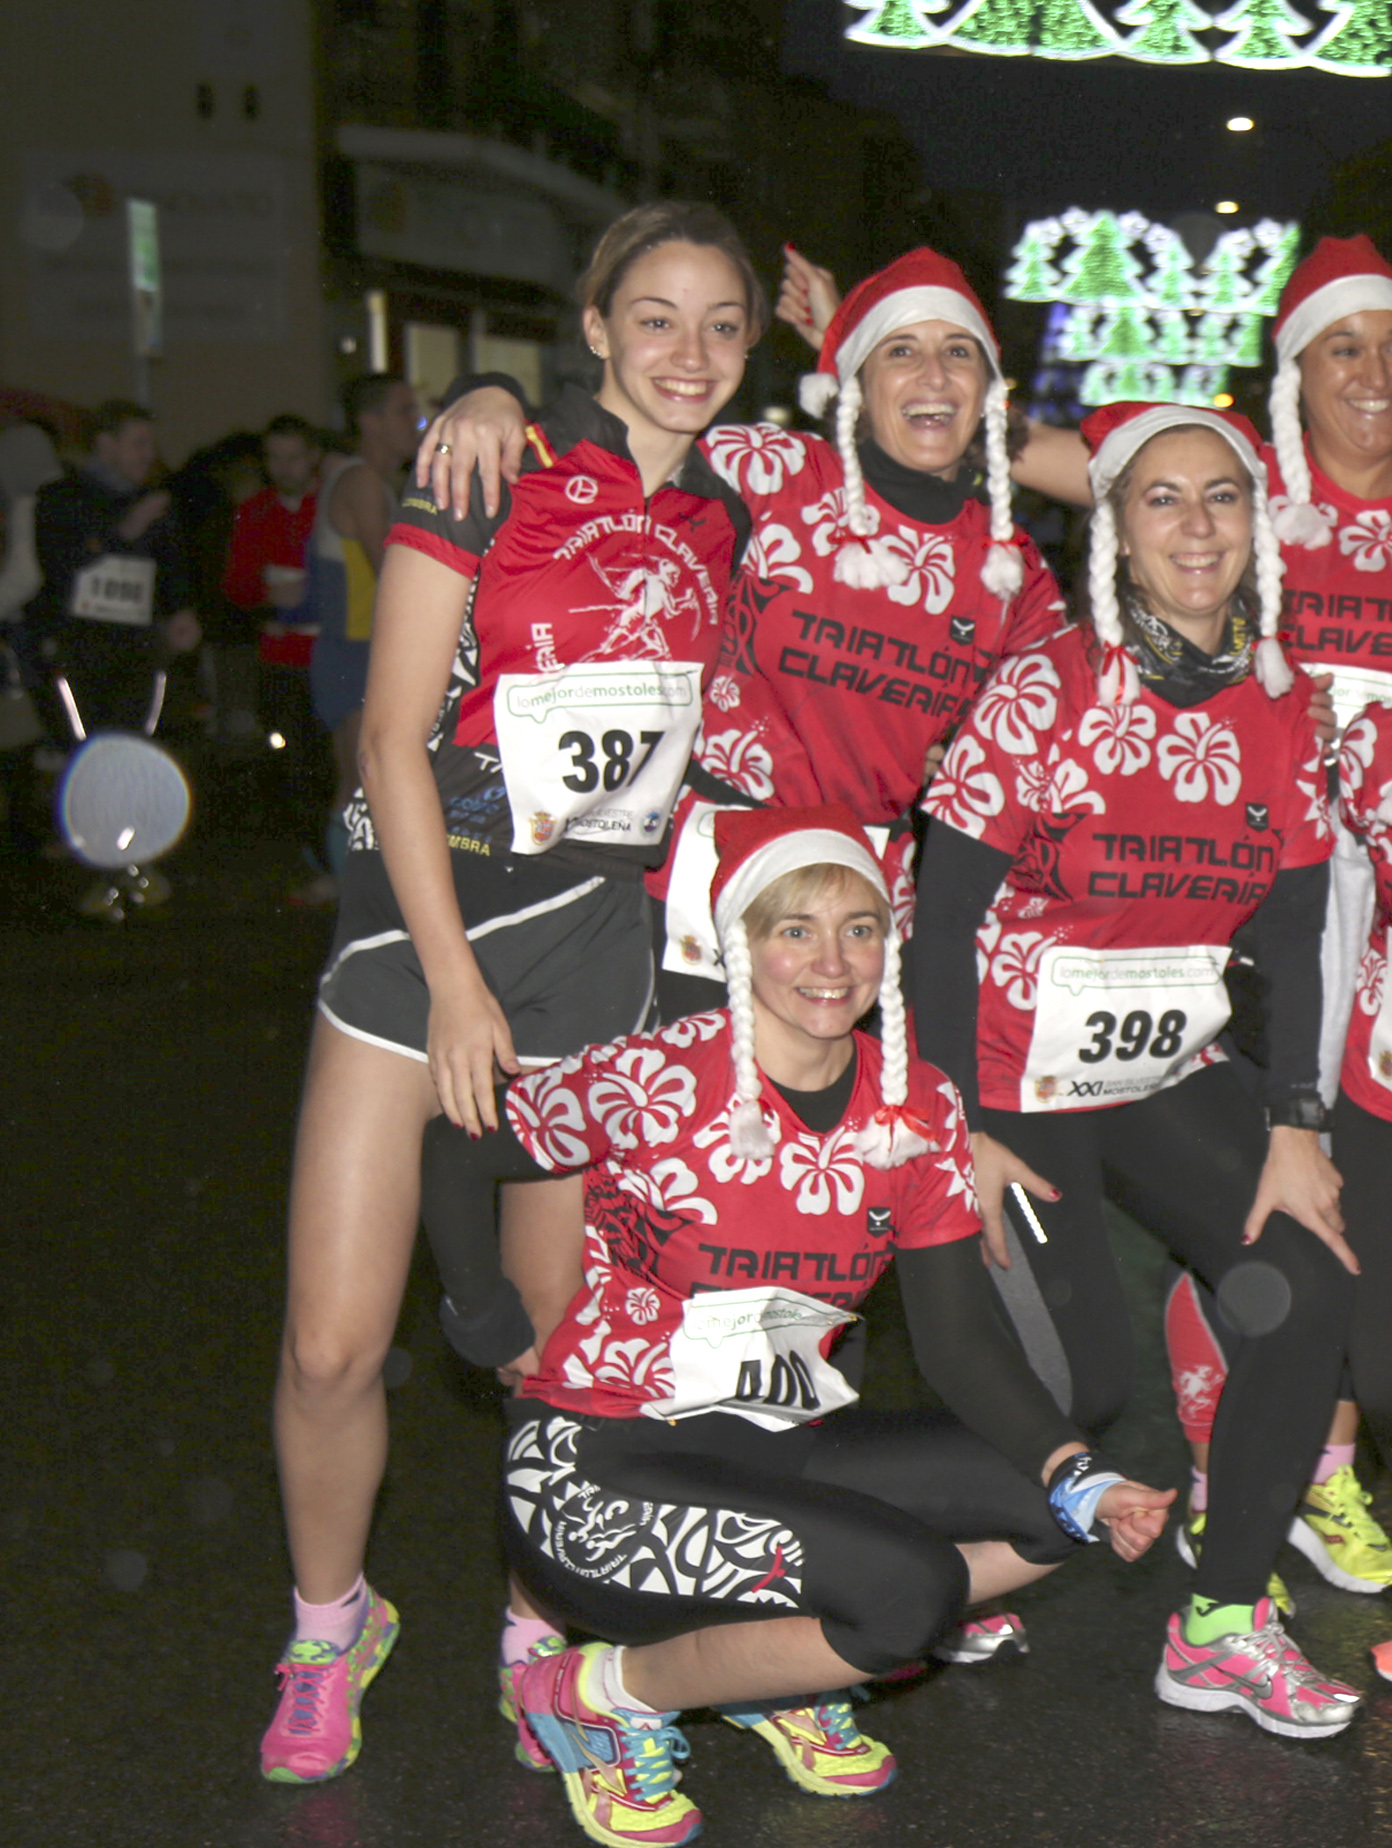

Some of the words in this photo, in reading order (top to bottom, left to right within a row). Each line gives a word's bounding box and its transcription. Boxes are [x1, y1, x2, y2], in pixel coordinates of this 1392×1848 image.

[792, 609, 970, 685] TRIATLÓN
[558, 729, 665, 793] 387
[1092, 833, 1275, 873] TRIATLÓN
[1078, 1009, 1187, 1064] 398
[1067, 1080, 1104, 1097] XXI
